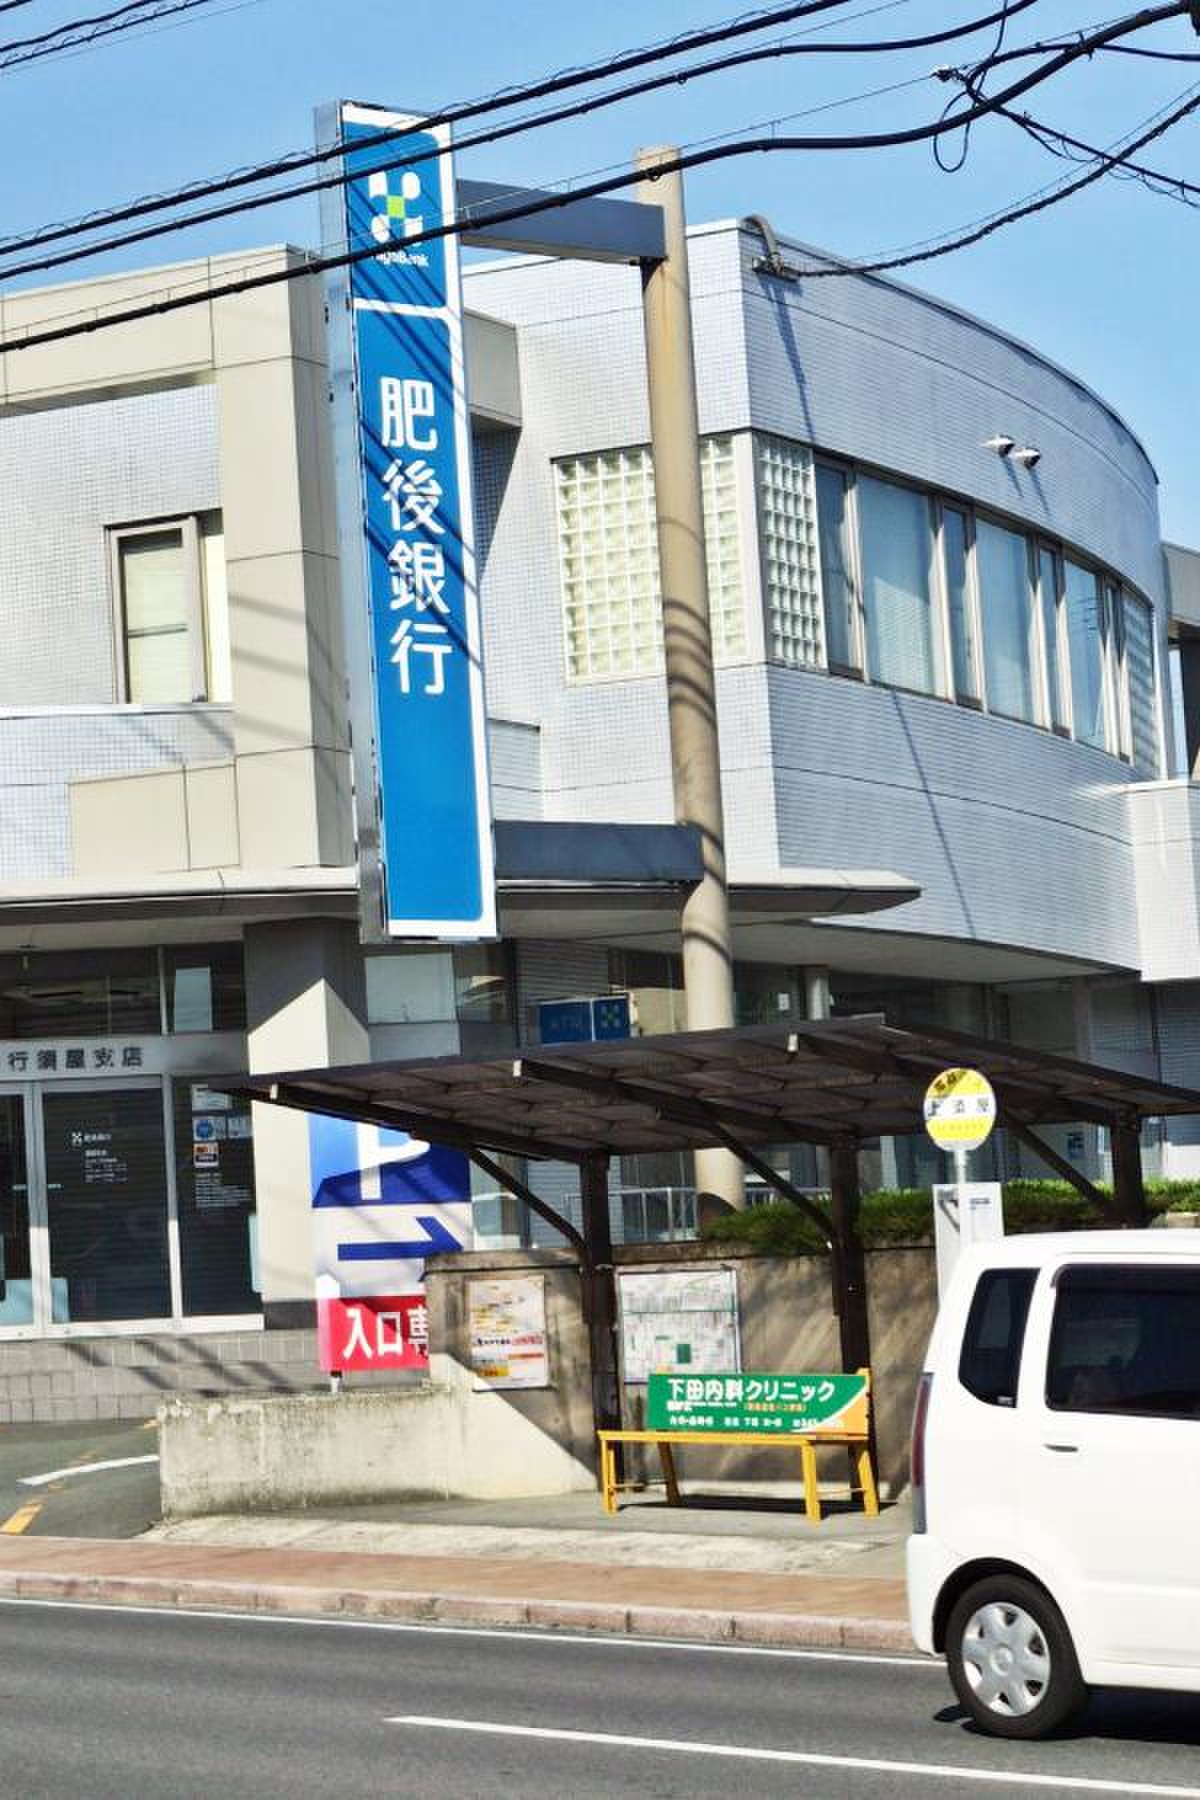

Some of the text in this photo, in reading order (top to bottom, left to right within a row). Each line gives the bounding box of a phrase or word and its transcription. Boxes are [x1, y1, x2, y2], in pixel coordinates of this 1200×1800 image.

[380, 376, 454, 697] 肥後銀行
[666, 1378, 836, 1402] 下田内科クリニック
